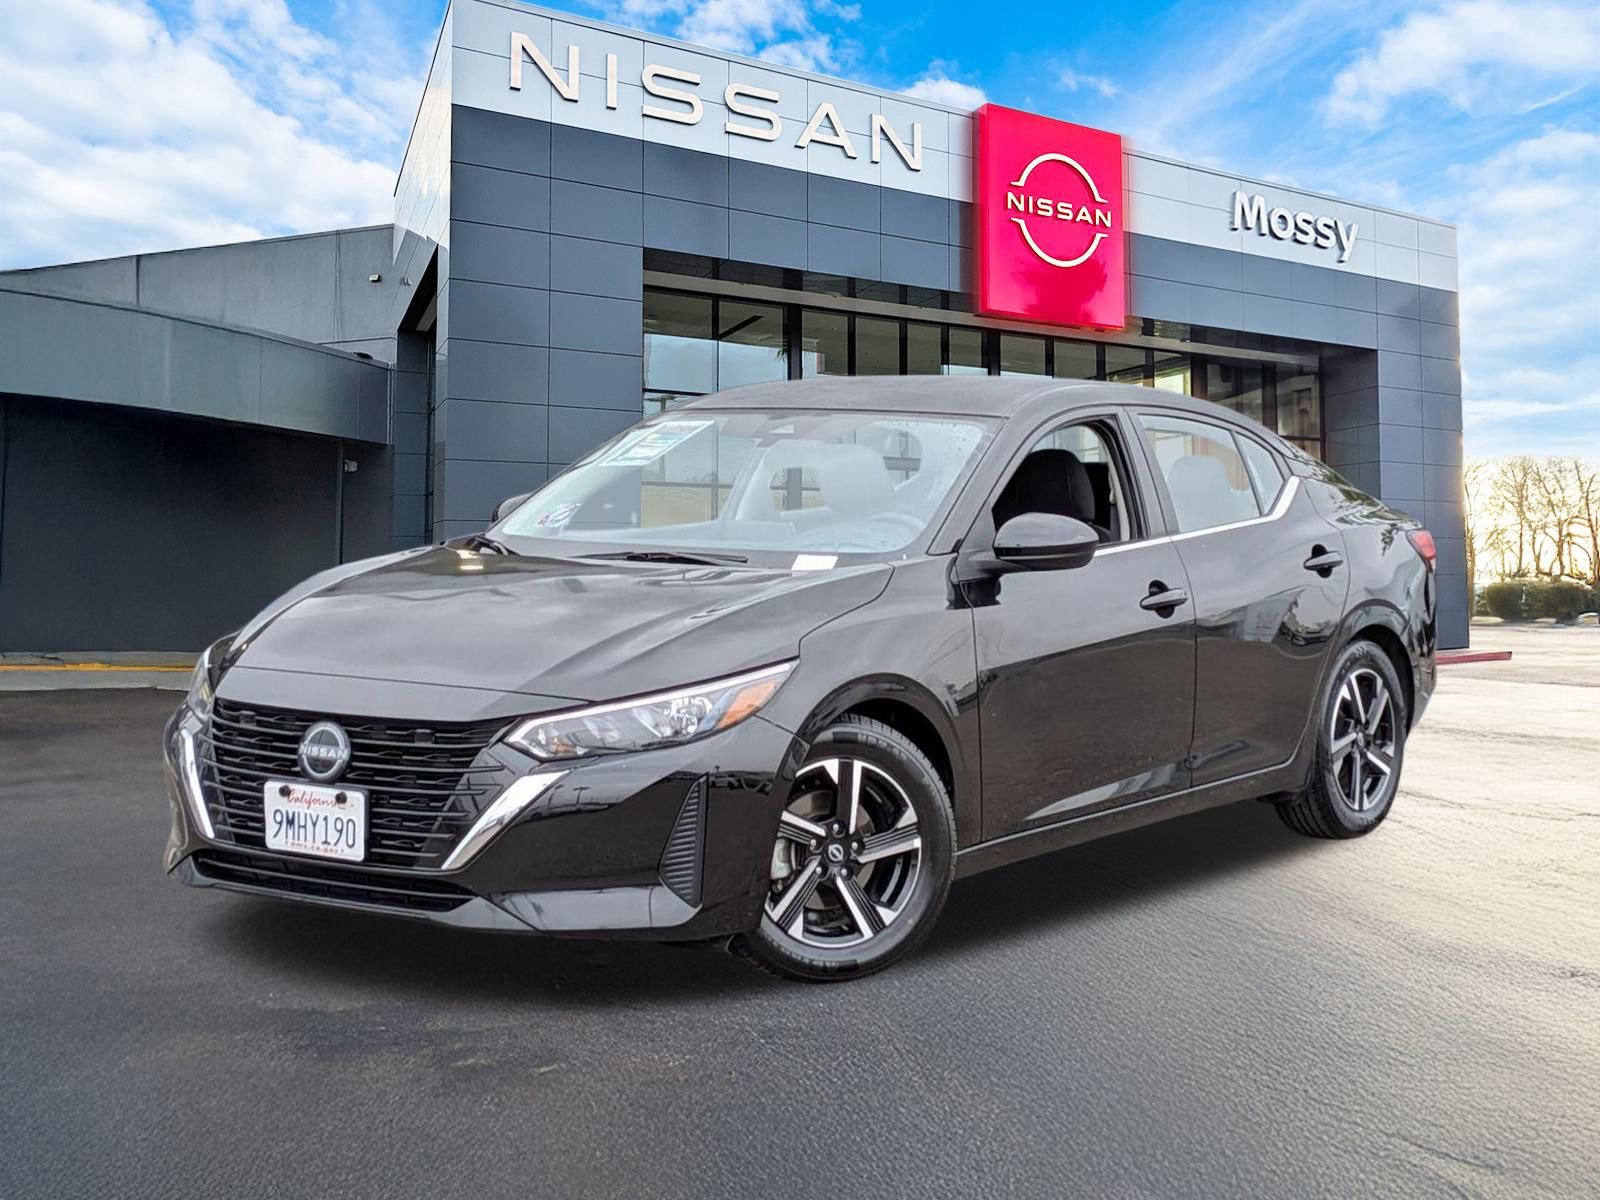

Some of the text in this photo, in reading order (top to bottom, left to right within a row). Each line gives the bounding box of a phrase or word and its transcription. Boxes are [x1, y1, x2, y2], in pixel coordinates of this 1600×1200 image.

[509, 31, 922, 171] NISSAN
[1006, 191, 1112, 228] NISSAN
[1229, 190, 1360, 263] Mossy
[300, 744, 348, 760] NISSAN
[286, 788, 341, 810] Californi
[272, 808, 356, 849] 9MHY190
